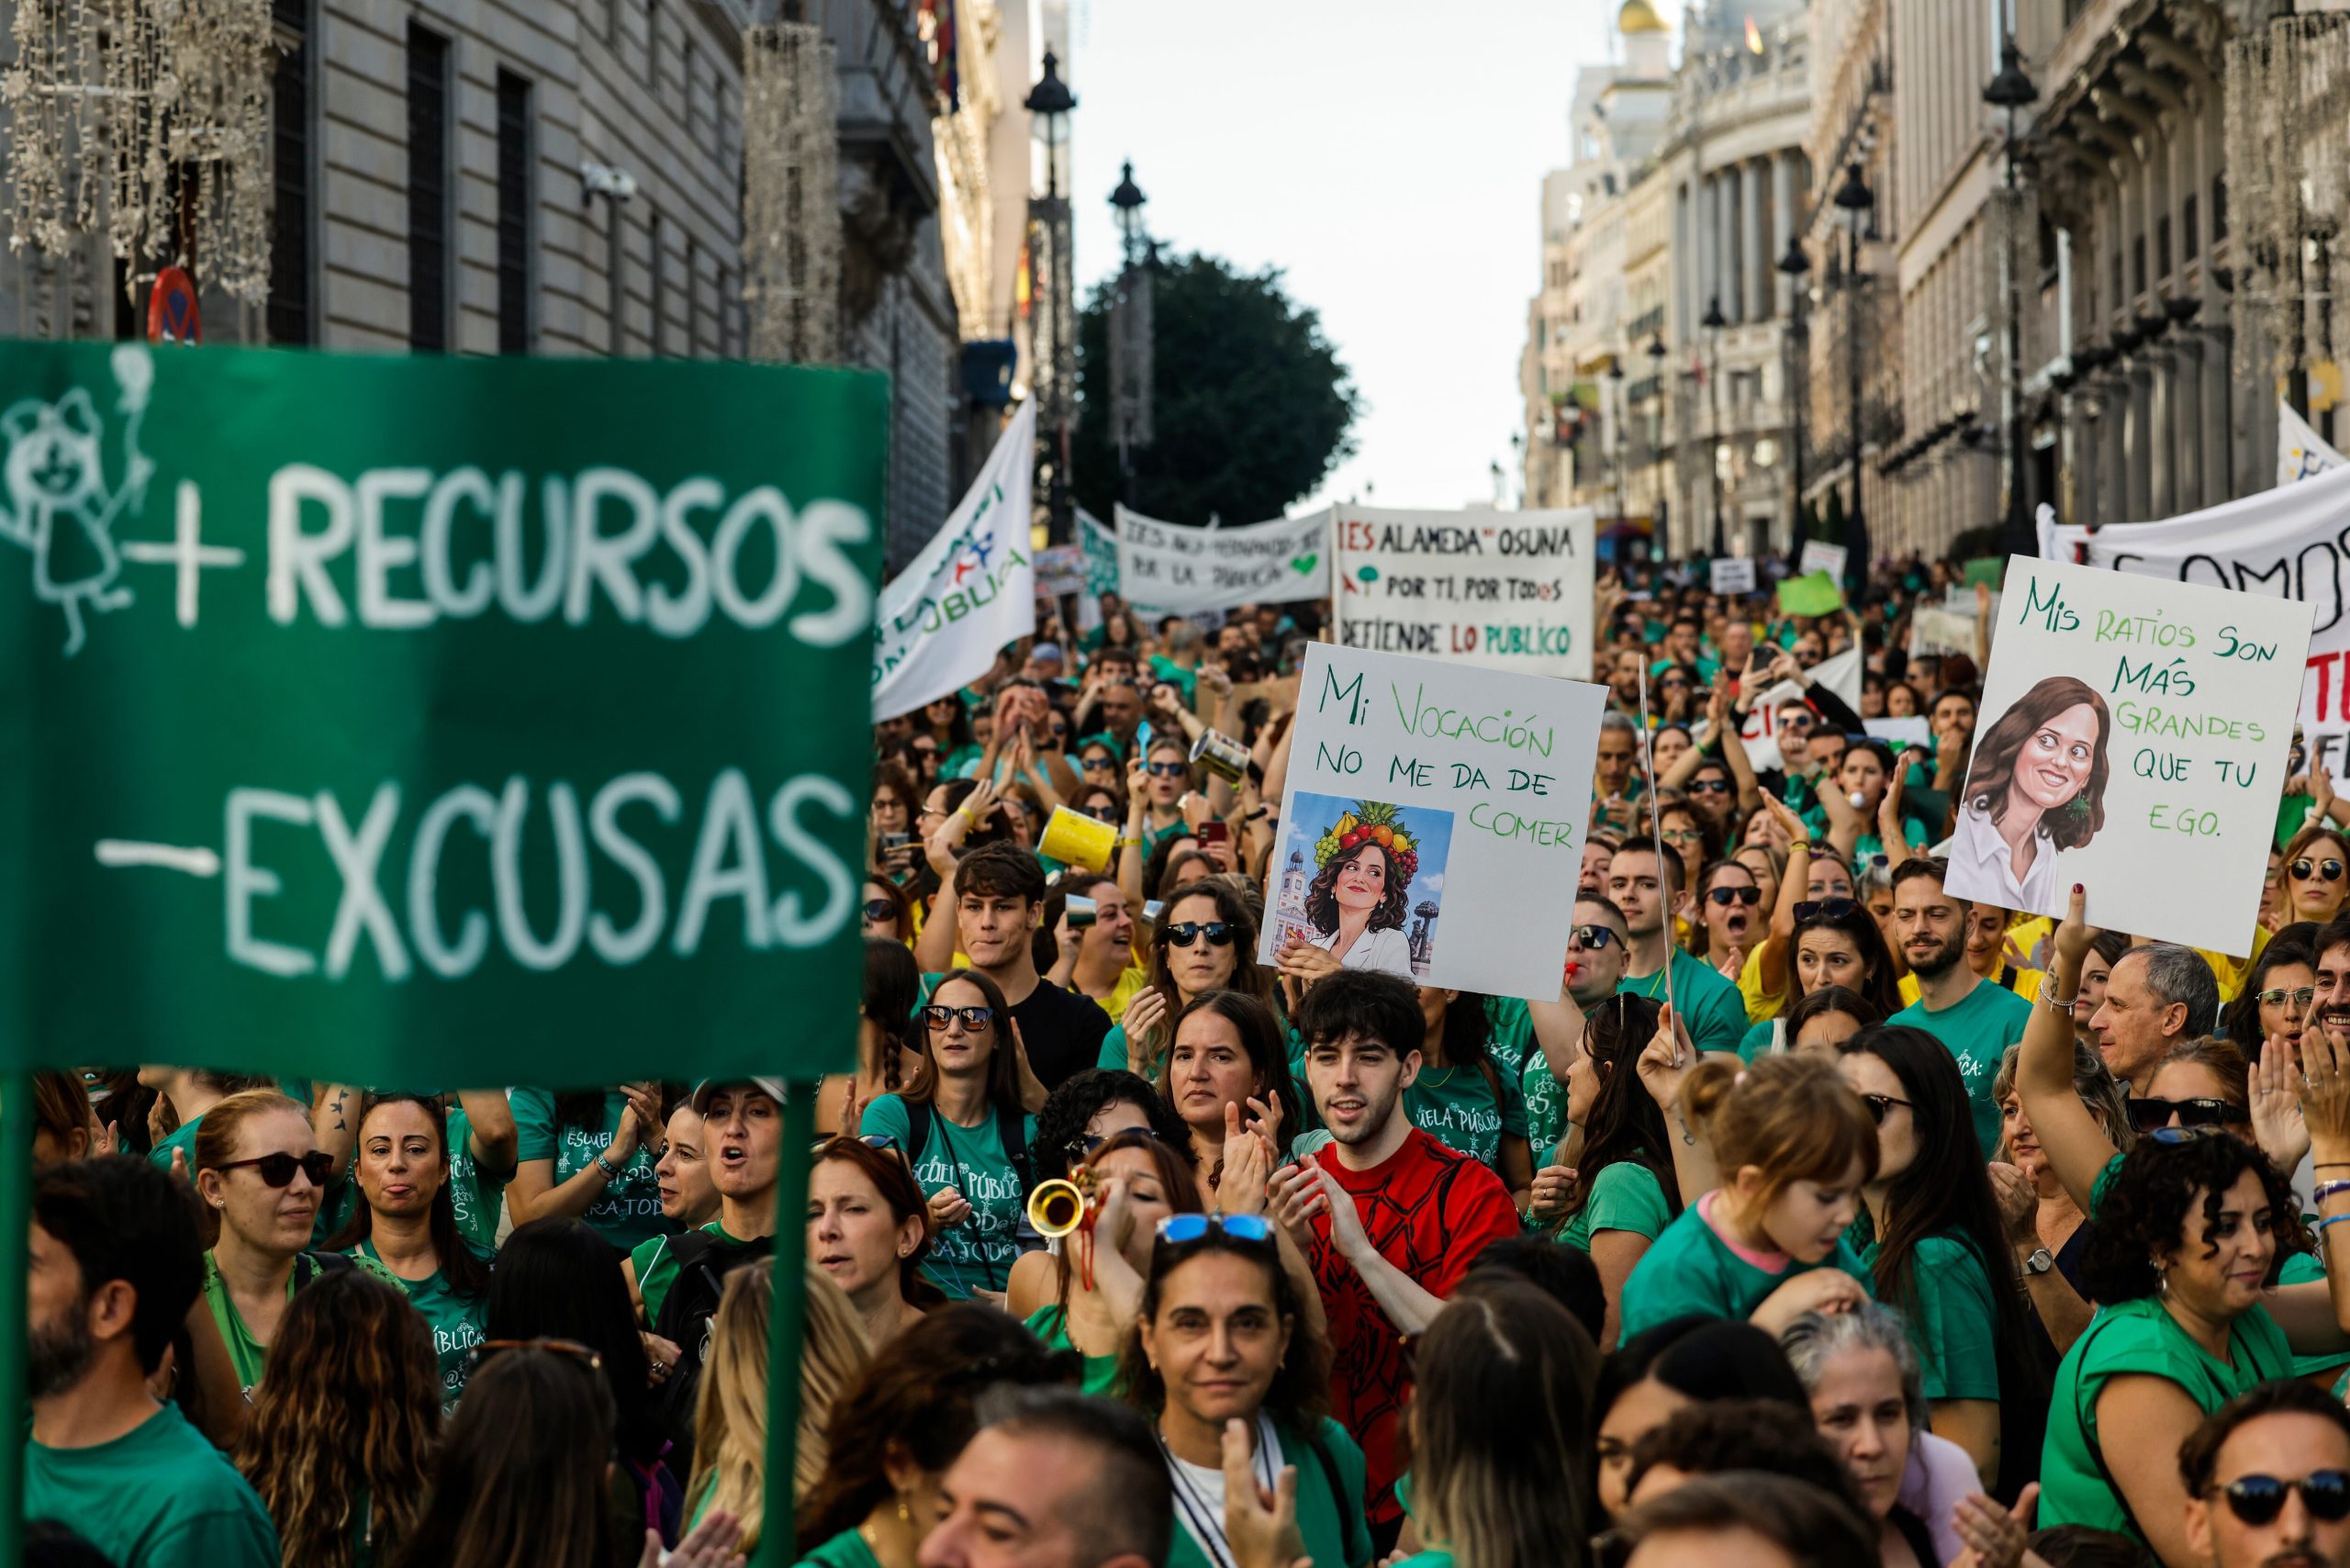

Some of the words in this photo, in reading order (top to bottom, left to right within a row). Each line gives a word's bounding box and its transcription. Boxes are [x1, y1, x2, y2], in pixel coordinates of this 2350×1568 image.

[267, 462, 875, 648] RECURSOS
[1380, 522, 1483, 556] ALAMEDA
[1498, 527, 1574, 557] OSUNA
[1387, 576, 1426, 598] POR
[1464, 576, 1501, 601] POR
[1450, 622, 1478, 654] LO
[1319, 663, 1370, 726] Mi
[2110, 655, 2196, 697] MÁS
[2116, 700, 2266, 743] GRANDES
[1315, 741, 1362, 775] NO
[1389, 755, 1435, 788] ME
[1450, 763, 1490, 790] DA
[1506, 768, 1556, 796] DE
[2133, 748, 2191, 781] QUE
[2214, 760, 2256, 788] TU
[1469, 802, 1572, 849] COMER
[2148, 804, 2221, 837] EGO.
[225, 767, 859, 980] EXCUSAS
